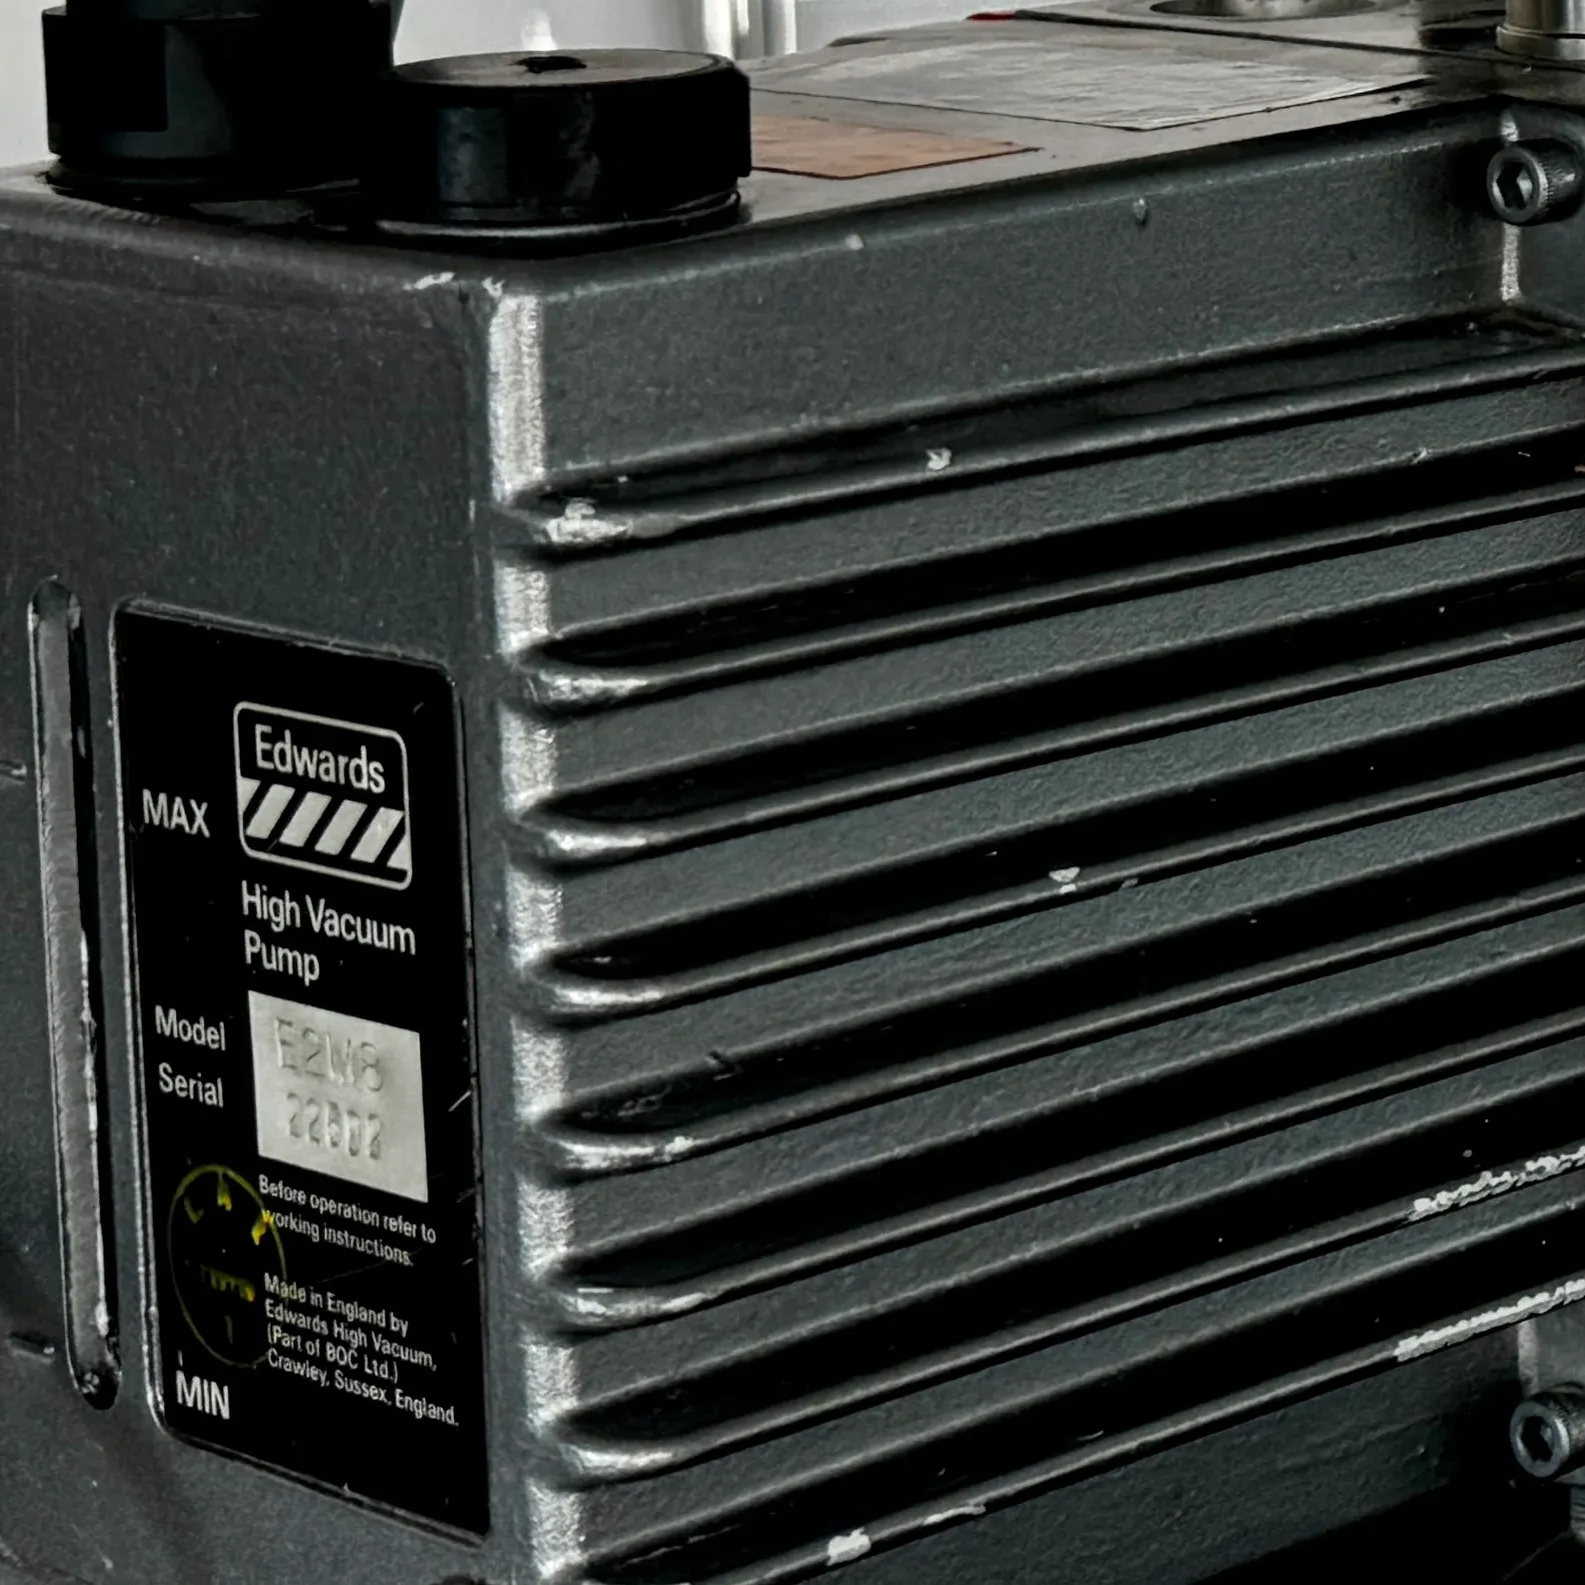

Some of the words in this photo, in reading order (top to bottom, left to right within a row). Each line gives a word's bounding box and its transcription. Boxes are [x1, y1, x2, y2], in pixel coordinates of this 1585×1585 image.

[255, 723, 386, 794] Edwards
[142, 788, 210, 838] MAX
[241, 880, 301, 932] High
[305, 894, 416, 955] Vacuum
[244, 930, 320, 986] Pump
[155, 1005, 226, 1051] Model
[158, 1063, 224, 1108] Serial
[258, 1174, 307, 1205] Before
[310, 1194, 380, 1227] operation
[383, 1215, 417, 1238] refer
[421, 1223, 436, 1244] to
[324, 1222, 414, 1267] instructions.
[264, 1272, 306, 1303] Made
[310, 1287, 323, 1308] in
[327, 1291, 386, 1328] England
[390, 1312, 409, 1338] by
[265, 1298, 329, 1336] Edwards
[333, 1319, 368, 1349] High
[371, 1330, 437, 1372] Vacuum,
[267, 1322, 303, 1352] (Part
[305, 1338, 320, 1358] of
[325, 1341, 358, 1370] BOC
[364, 1354, 398, 1384] Ltd.)
[176, 1370, 230, 1420] MIN
[268, 1347, 330, 1387] Crawley,
[395, 1388, 459, 1427] England.
